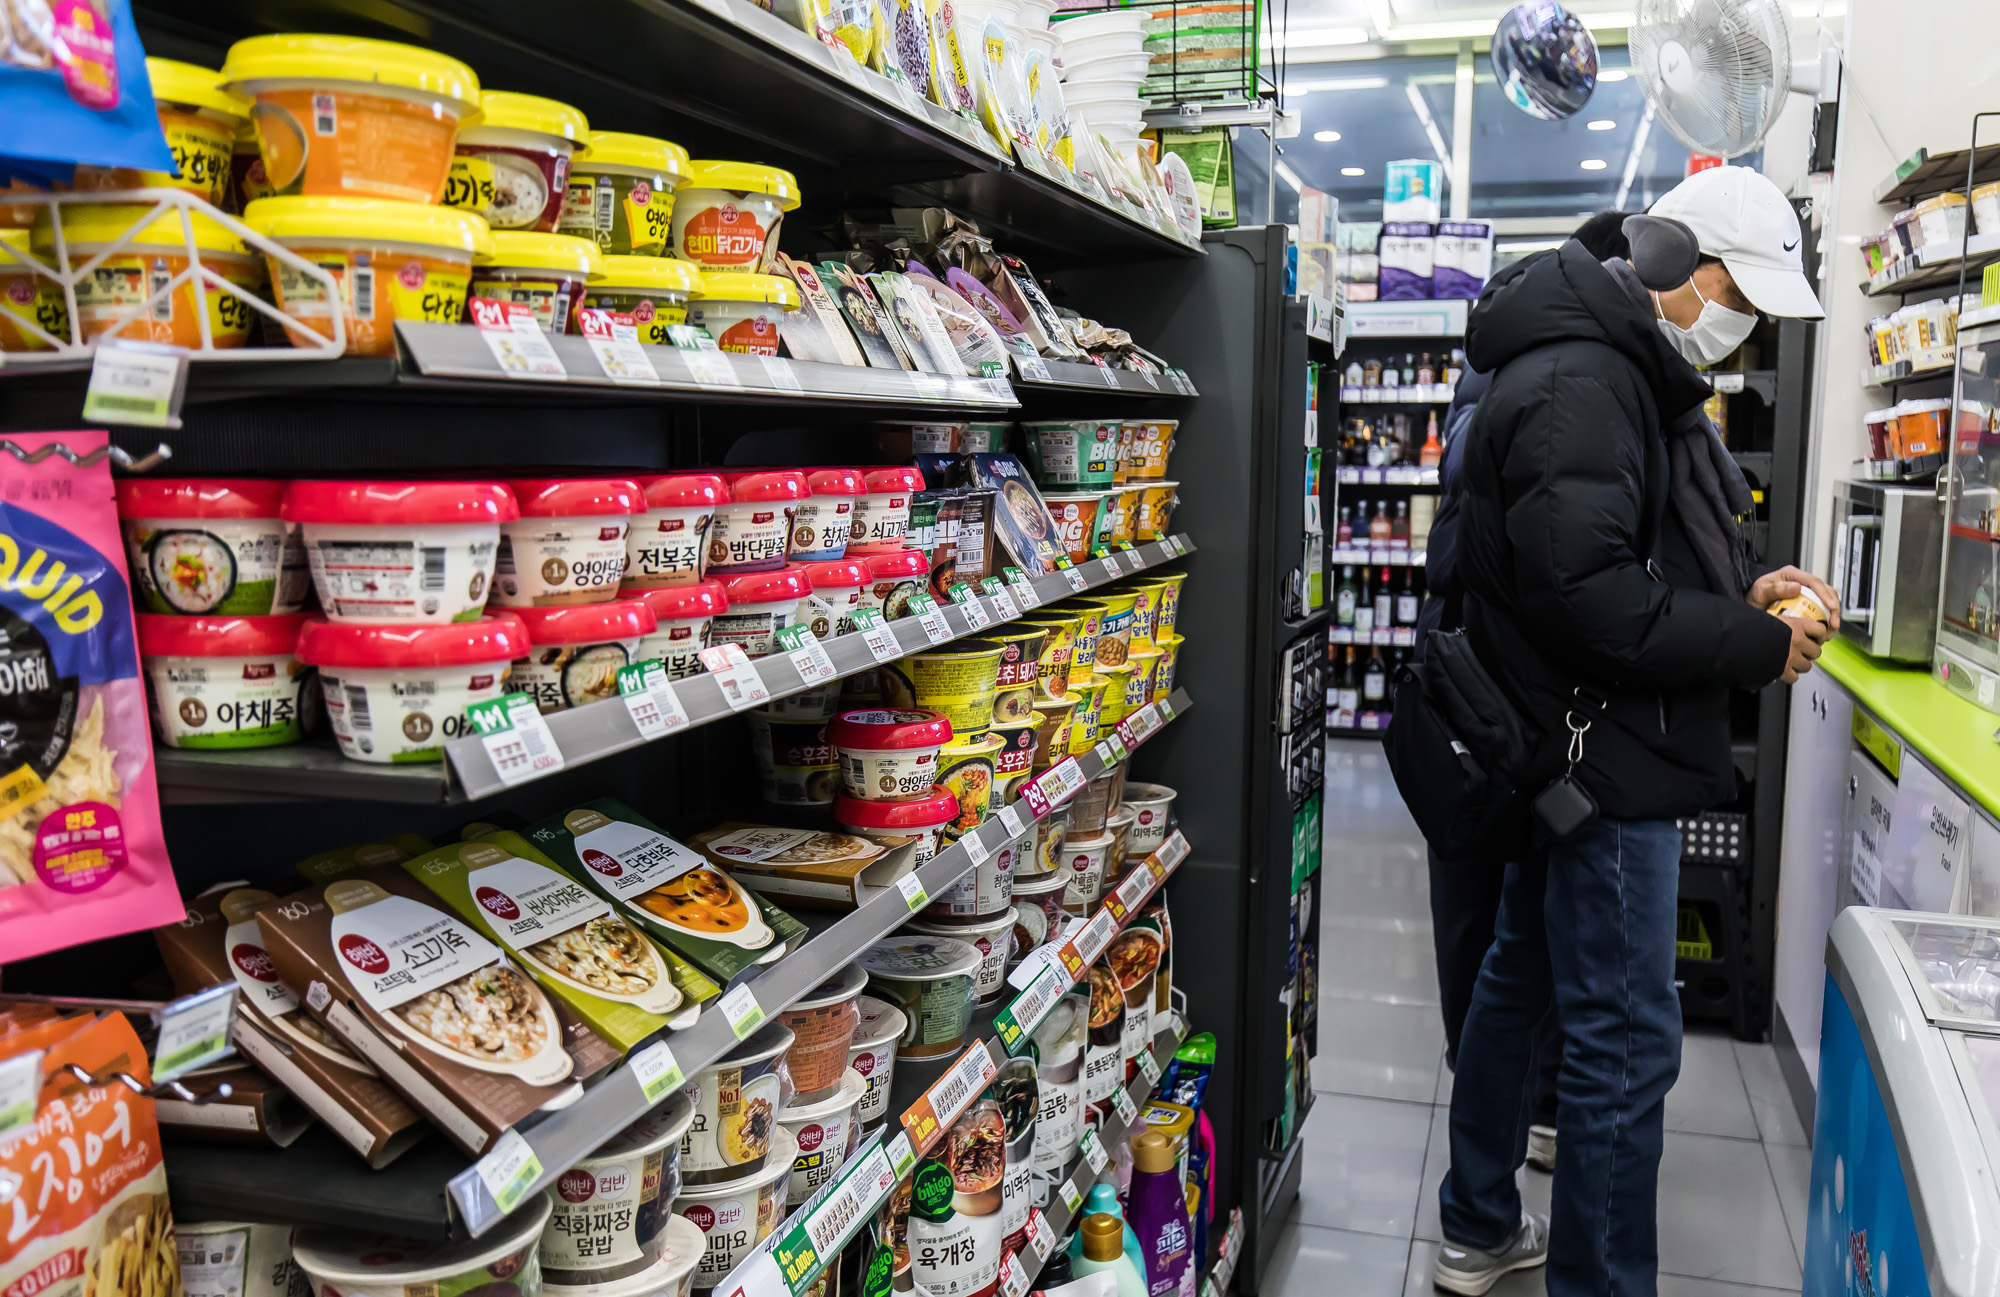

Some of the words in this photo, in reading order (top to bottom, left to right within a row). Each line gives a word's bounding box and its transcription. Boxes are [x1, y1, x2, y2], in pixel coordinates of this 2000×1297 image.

[687, 235, 765, 256] 현미닭고기죽
[1131, 440, 1163, 457] BIG
[729, 536, 786, 562] 밤단팥죽
[637, 546, 697, 575] 전복죽
[1006, 570, 1019, 583] 1+1
[950, 588, 964, 604] 1+1
[983, 582, 997, 596] 1+1
[910, 598, 928, 614] 1+1
[854, 614, 873, 630] 1+1
[781, 631, 801, 651] 1+1
[619, 668, 644, 694] 1+1
[217, 697, 294, 731] 야채죽
[473, 704, 508, 734] 1+1
[995, 750, 1026, 773] 후추
[1024, 783, 1046, 809] 2+2
[533, 828, 556, 843] 195
[1930, 804, 1959, 852] 일반쓰레기
[423, 858, 450, 875] 155
[588, 854, 619, 873] 햇반
[624, 842, 680, 874] 단호박죽
[1940, 852, 1952, 874] Trash
[613, 871, 646, 890] 소프트밀
[278, 901, 310, 921] 160
[482, 893, 516, 915] 햇반
[524, 883, 591, 917] 버섯야채죽
[508, 916, 545, 936] 소프트밀
[345, 940, 385, 969] 햇반
[402, 927, 471, 970] 소고기죽
[372, 968, 417, 994] 소프트밀
[980, 971, 998, 985] 덮밥
[854, 1060, 874, 1073] 햇반
[876, 1053, 889, 1067] 컵반
[874, 1069, 890, 1088] 마요
[719, 1087, 740, 1104] No.1
[860, 1090, 882, 1110] 덮밥
[801, 1130, 822, 1146] 햇반
[826, 1122, 842, 1140] 컵반
[794, 1154, 821, 1170] 스팸
[825, 1141, 845, 1165] 김치
[561, 1178, 592, 1196] 햇반
[599, 1175, 626, 1194] 컵반
[642, 1169, 661, 1189] No.1
[806, 1165, 833, 1187] 덮밥
[1003, 1168, 1031, 1200] 미역국
[916, 1175, 951, 1202] bibigo
[718, 1206, 742, 1225] 컵반
[757, 1202, 773, 1217] No.1
[553, 1208, 633, 1237] 직화짜장
[577, 1235, 614, 1258] 덮밥
[917, 1236, 976, 1271] 육개장
[700, 1251, 734, 1273] 덮밥
[786, 1248, 817, 1284] 10,000원
